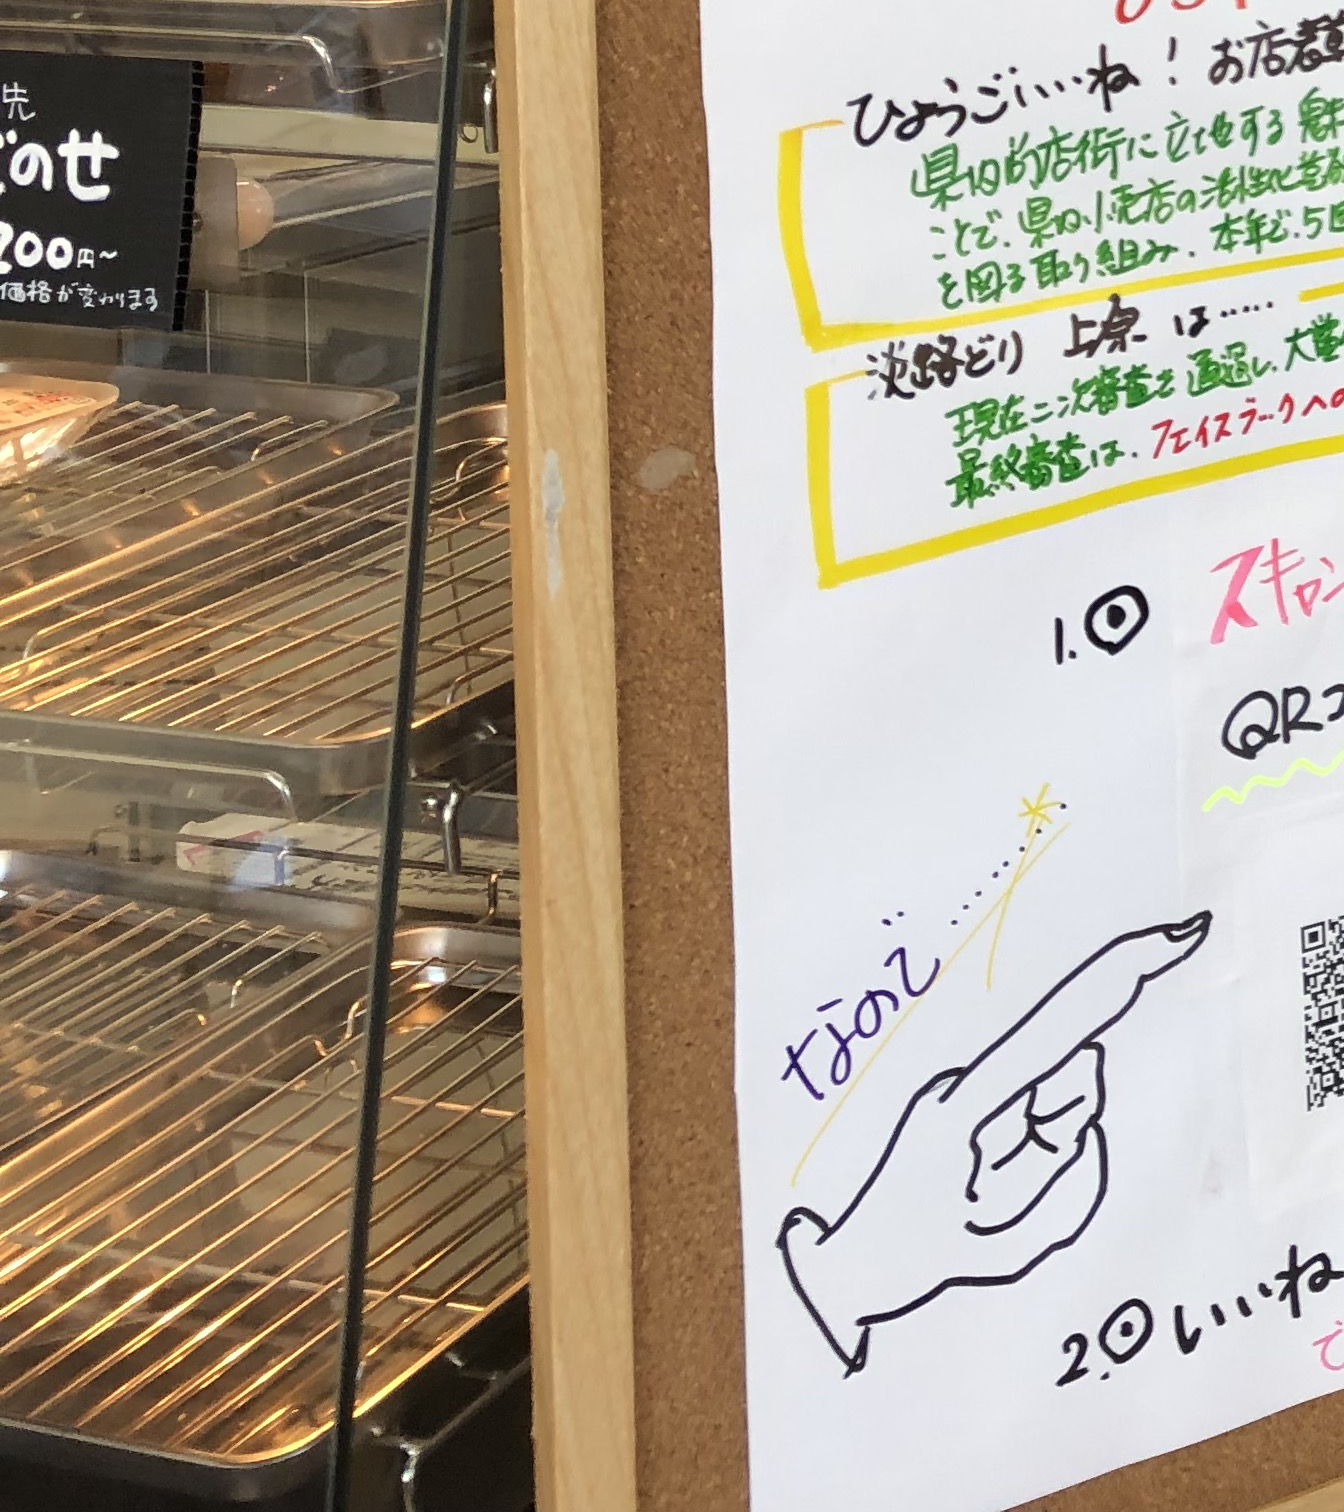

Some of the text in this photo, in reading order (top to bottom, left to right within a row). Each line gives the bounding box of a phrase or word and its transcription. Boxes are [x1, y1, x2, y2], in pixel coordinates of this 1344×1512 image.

[864, 330, 1025, 401] 淡路どり
[1063, 292, 1148, 359] 上原
